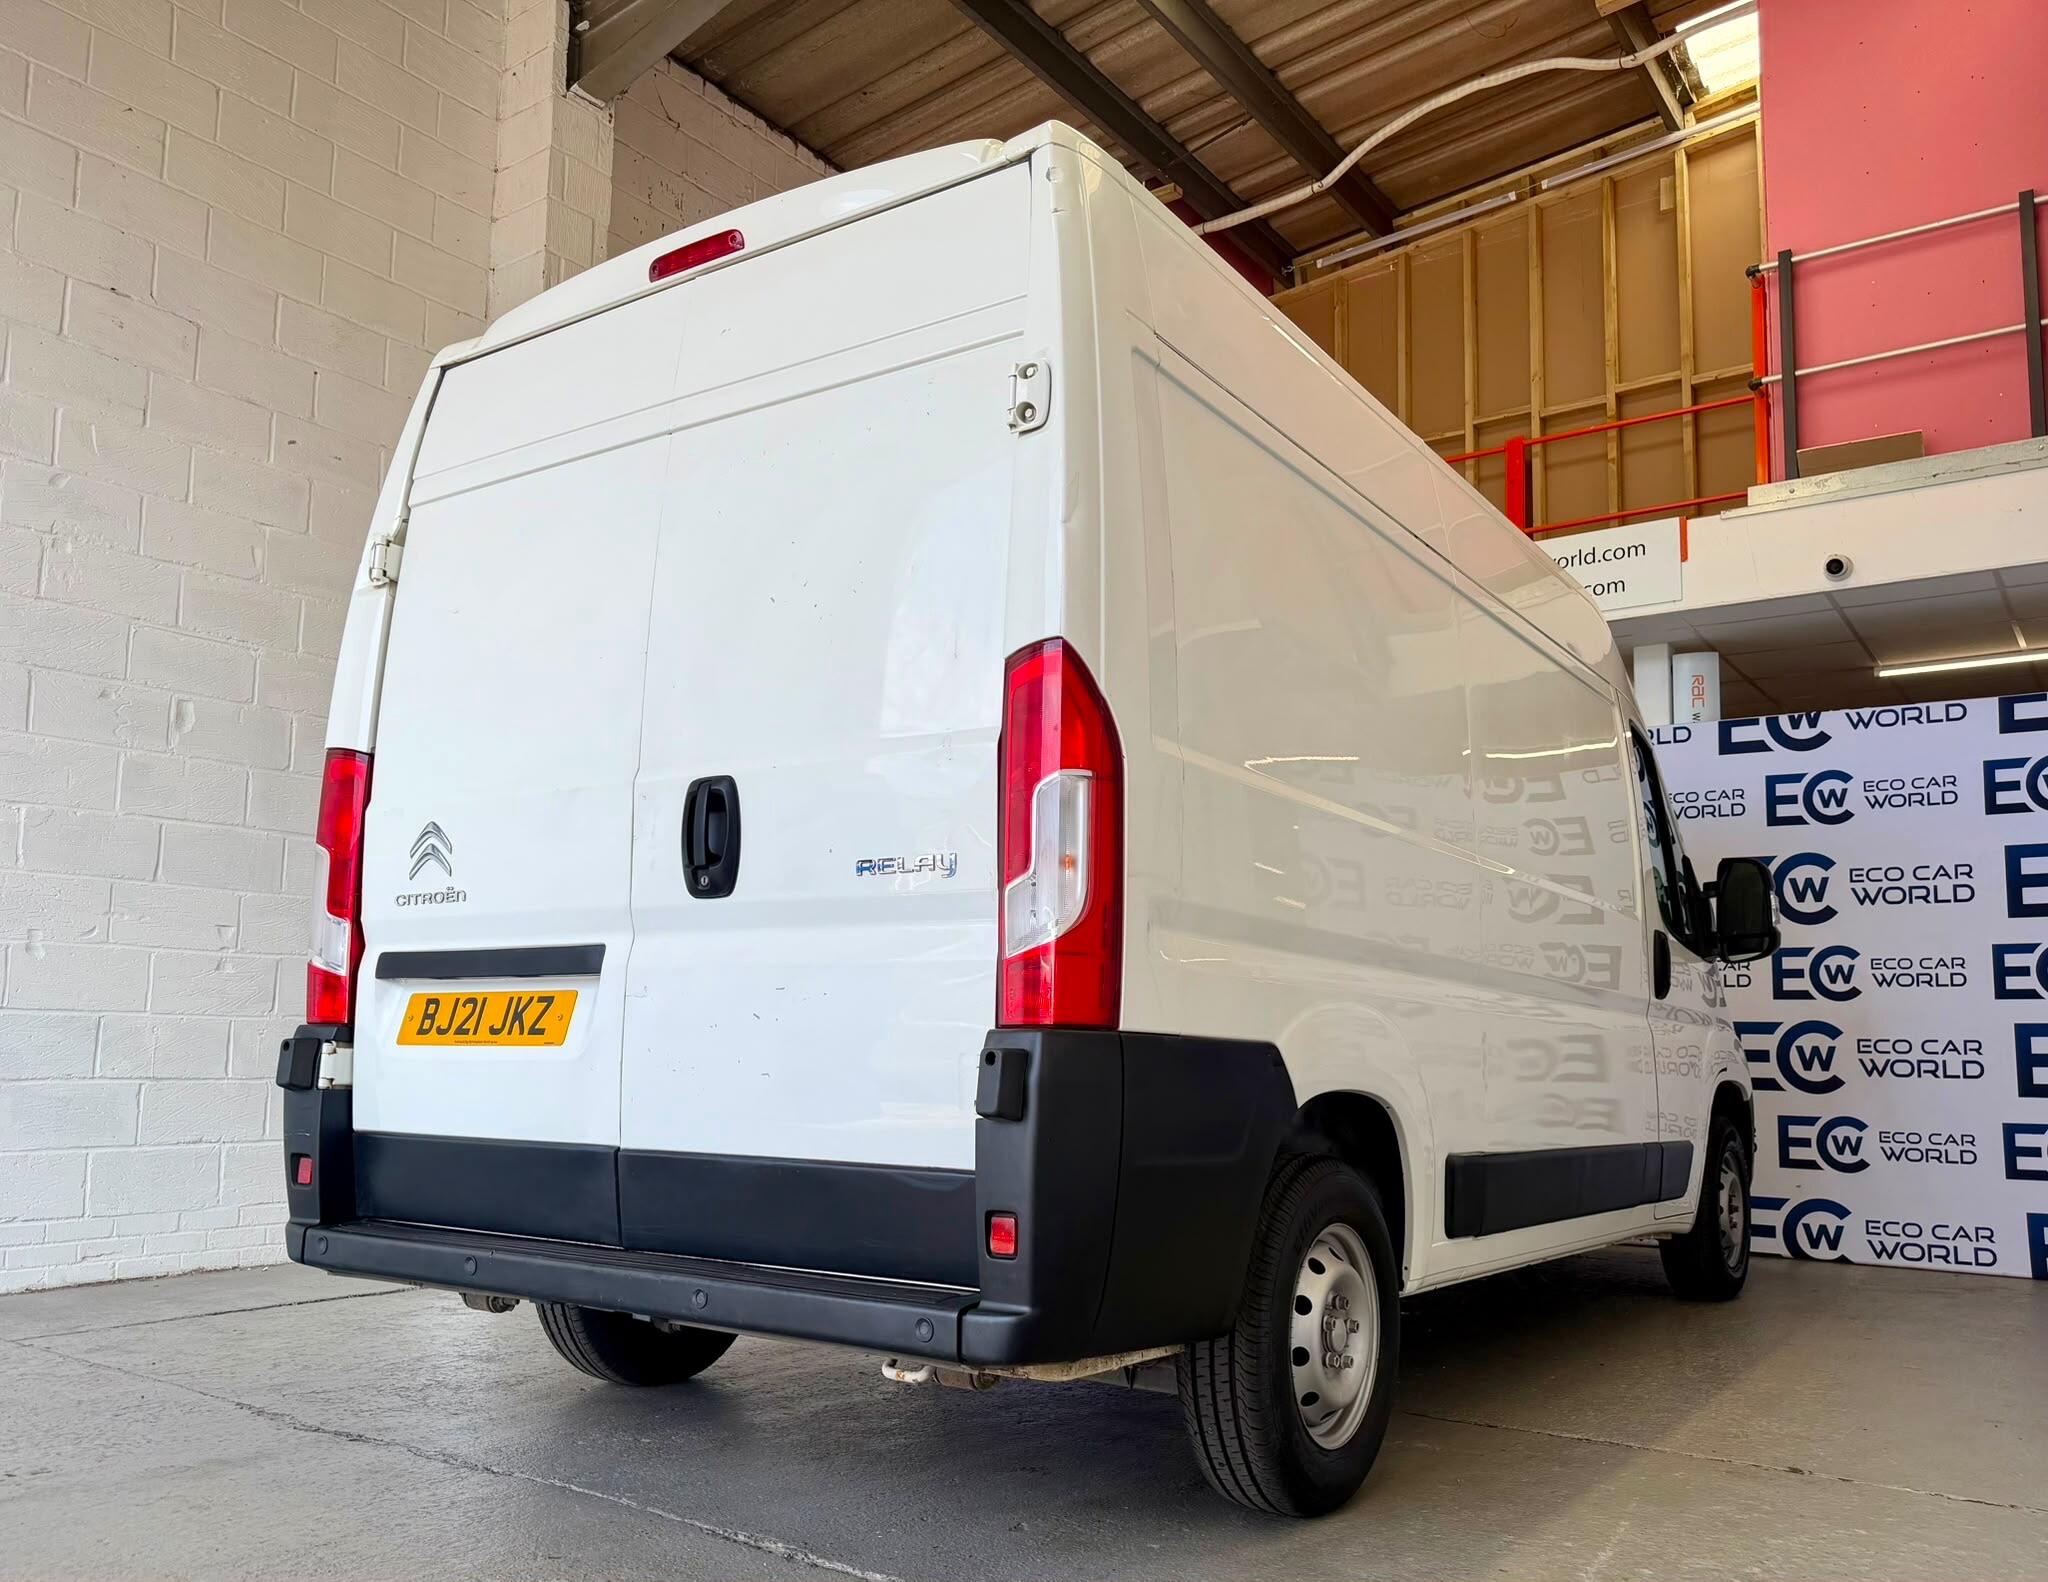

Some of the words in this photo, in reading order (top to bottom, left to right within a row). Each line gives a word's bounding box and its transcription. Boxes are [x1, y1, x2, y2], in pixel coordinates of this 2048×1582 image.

[1553, 543, 1646, 569] orld.com
[1845, 702, 1967, 730] WORLD
[1863, 779, 1905, 792] ECO
[1911, 775, 1957, 789] CAR
[1704, 789, 1745, 802] CAR
[1864, 790, 1958, 809] WORLD
[1849, 867, 1904, 883] ECO
[1912, 864, 1973, 880] CAR
[1851, 884, 1975, 905] WORLD
[1719, 960, 1751, 971] AR
[1870, 958, 1913, 970] ECO
[1919, 957, 1966, 970] CAR
[1872, 972, 1967, 988] WORLD
[416, 996, 488, 1036] BJ21
[488, 995, 555, 1036] JKZ
[1857, 1038, 1913, 1054] ECO
[1921, 1040, 1983, 1056] CAR
[1858, 1058, 1985, 1079] WORLD
[1879, 1131, 1922, 1144] ECO
[1928, 1133, 1976, 1147] CAR
[1880, 1146, 1978, 1165] WORLD
[1865, 1219, 1923, 1238] ECO
[1932, 1224, 1996, 1243] CAR
[1867, 1239, 1998, 1267] WORLD
